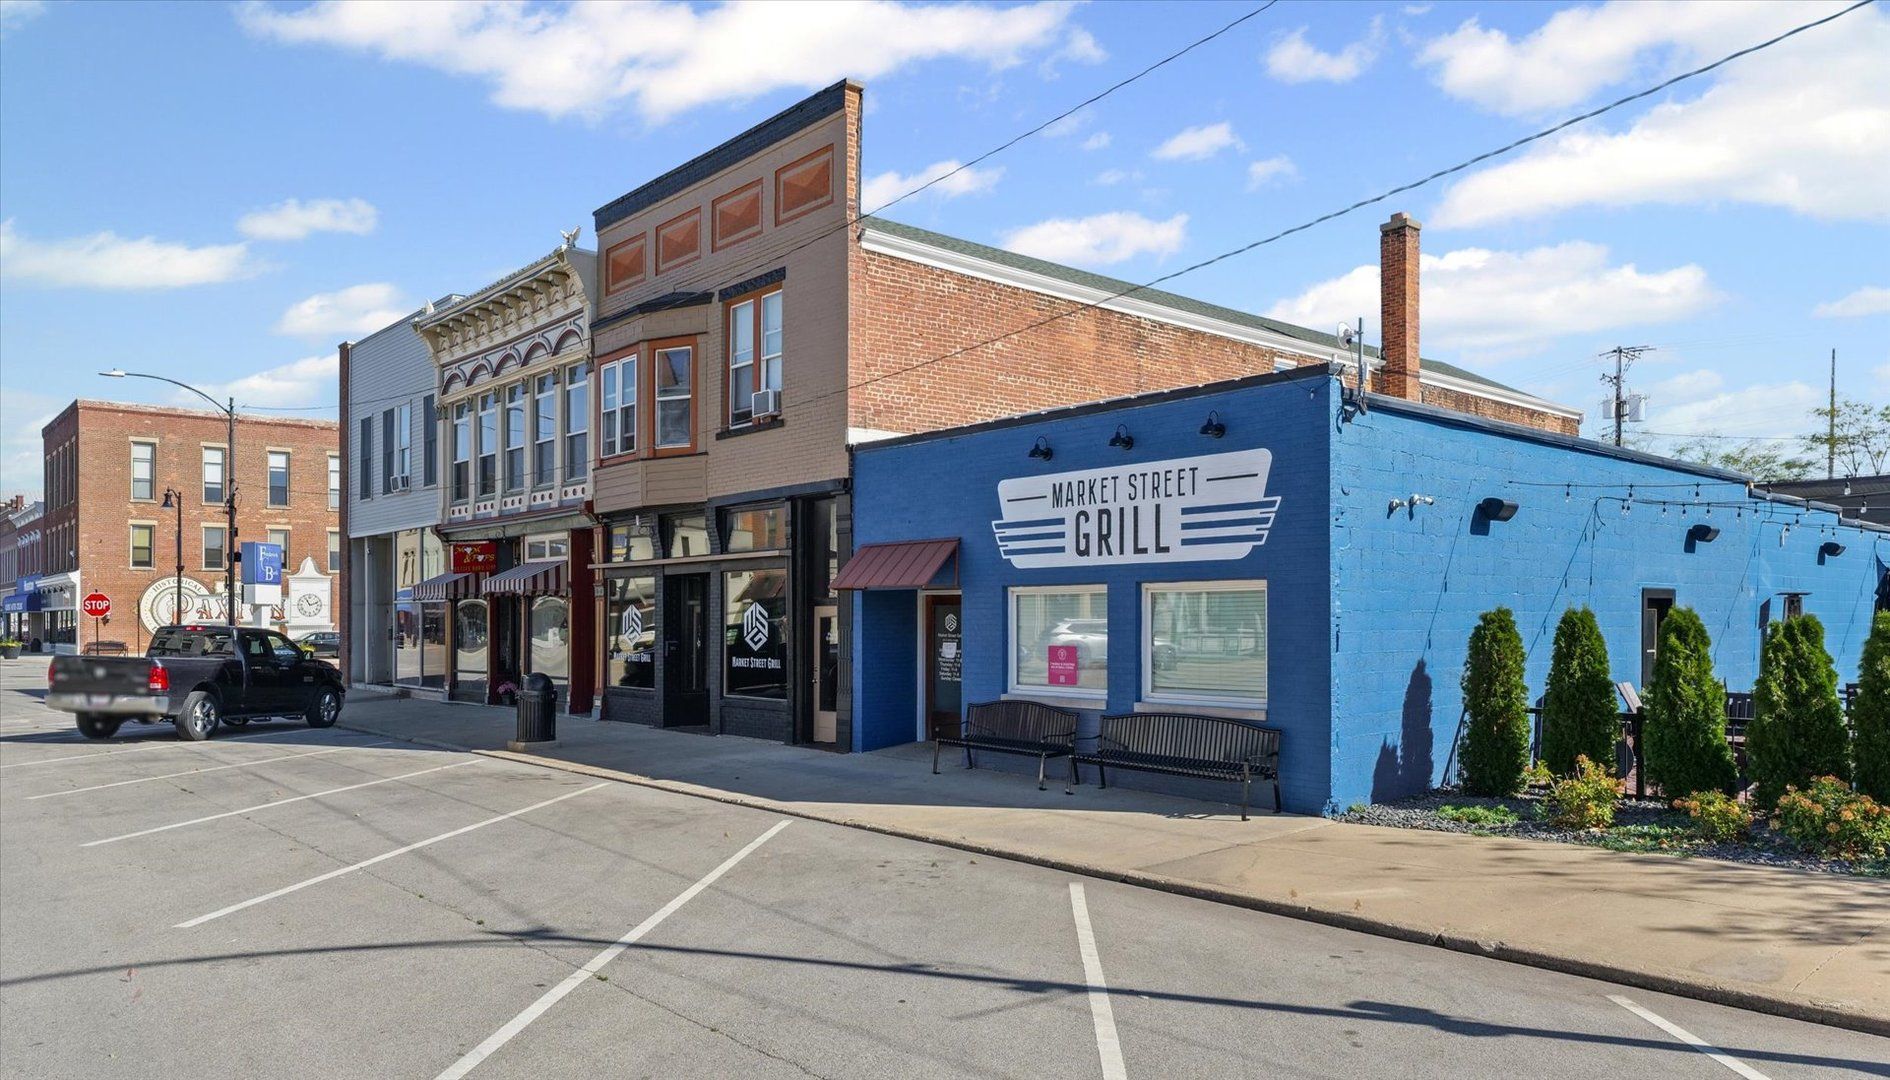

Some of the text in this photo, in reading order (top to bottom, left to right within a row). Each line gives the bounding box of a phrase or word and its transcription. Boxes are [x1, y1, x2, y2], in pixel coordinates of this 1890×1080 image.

[1052, 467, 1198, 508] MARKET STREET
[1075, 503, 1170, 557] GRILL
[84, 600, 110, 611] STOP
[166, 591, 286, 626] PAXTN
[751, 656, 767, 669] STREET
[767, 657, 781, 669] GRILL
